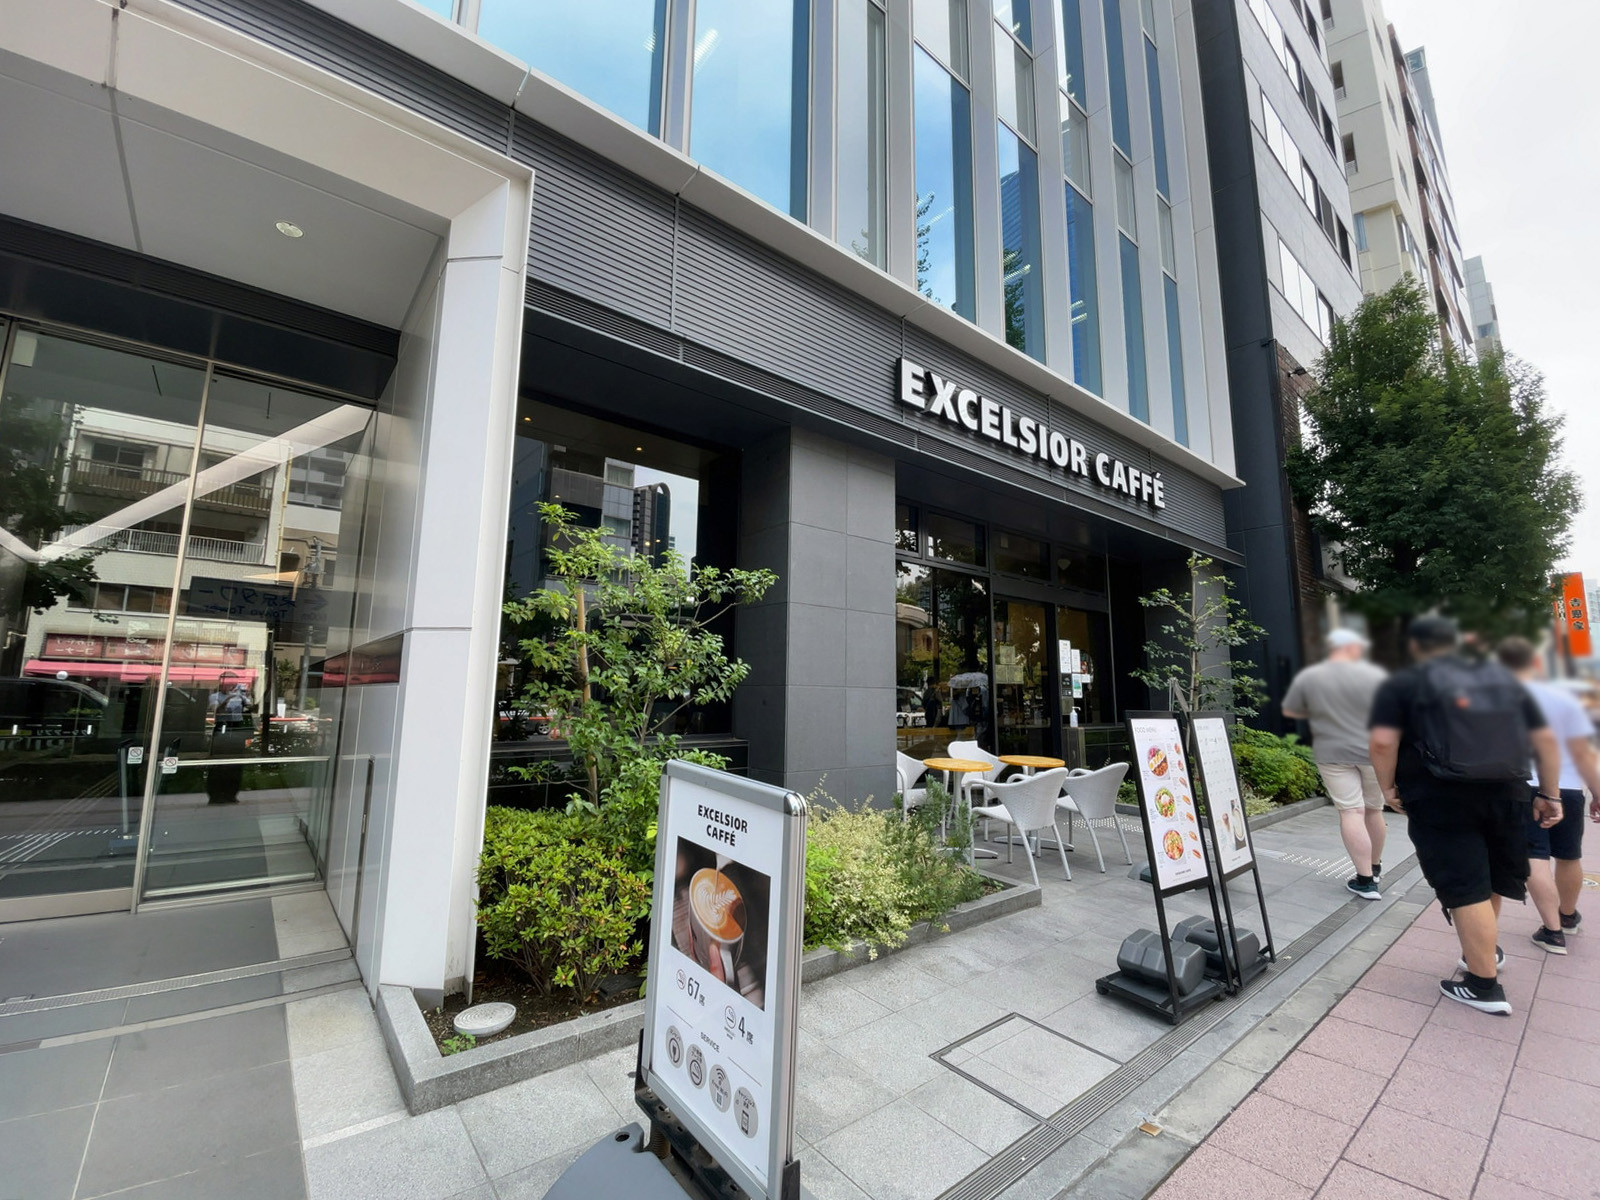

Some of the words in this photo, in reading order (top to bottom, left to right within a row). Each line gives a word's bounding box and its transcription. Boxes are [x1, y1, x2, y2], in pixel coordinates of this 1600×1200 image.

[899, 357, 1088, 477] EXCELSIOR
[1094, 452, 1166, 509] CAFFÉ
[698, 804, 748, 833] EXCELSIOR
[706, 824, 736, 847] CAFFÉ
